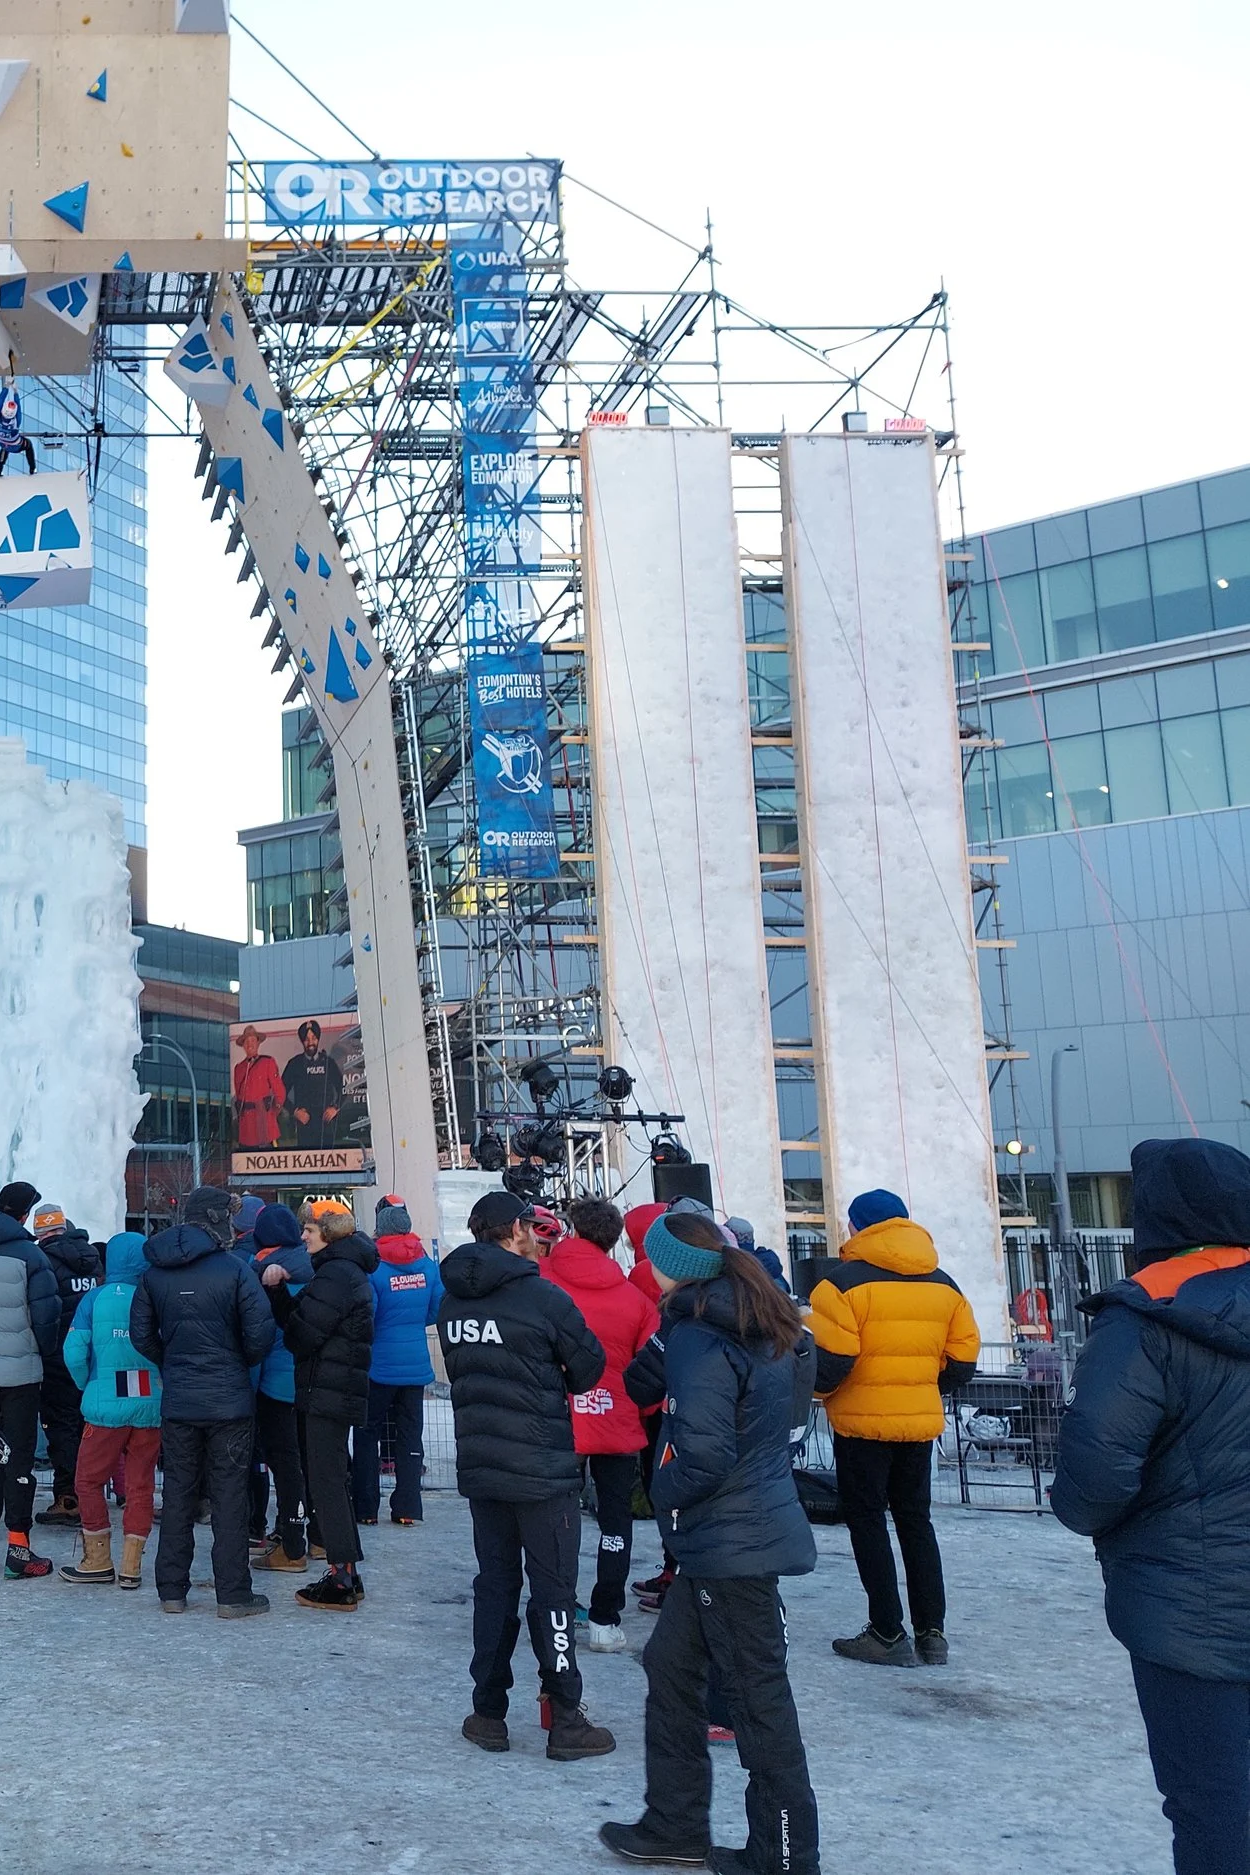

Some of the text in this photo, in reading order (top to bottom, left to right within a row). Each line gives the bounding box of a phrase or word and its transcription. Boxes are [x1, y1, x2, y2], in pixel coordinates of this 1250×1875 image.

[377, 166, 549, 191] OUTDOOR
[274, 163, 374, 216] OR
[382, 190, 551, 217] RESEARCH
[478, 252, 522, 266] UIAA
[471, 453, 532, 470] EXPLORE
[471, 470, 533, 484] EDMONTON
[477, 674, 541, 688] EDMONTON'S
[478, 685, 542, 704] Best HOTELS
[483, 831, 510, 846] OR
[511, 831, 554, 839] OUTDOOR
[512, 839, 556, 847] RESEARCH
[307, 1066, 325, 1074] POLICE
[246, 1153, 347, 1170] NOAH KAHAN
[71, 1277, 97, 1292] USA
[447, 1319, 503, 1344] USA
[550, 1611, 569, 1672] USA
[781, 1809, 790, 1857] SPORTIVA
